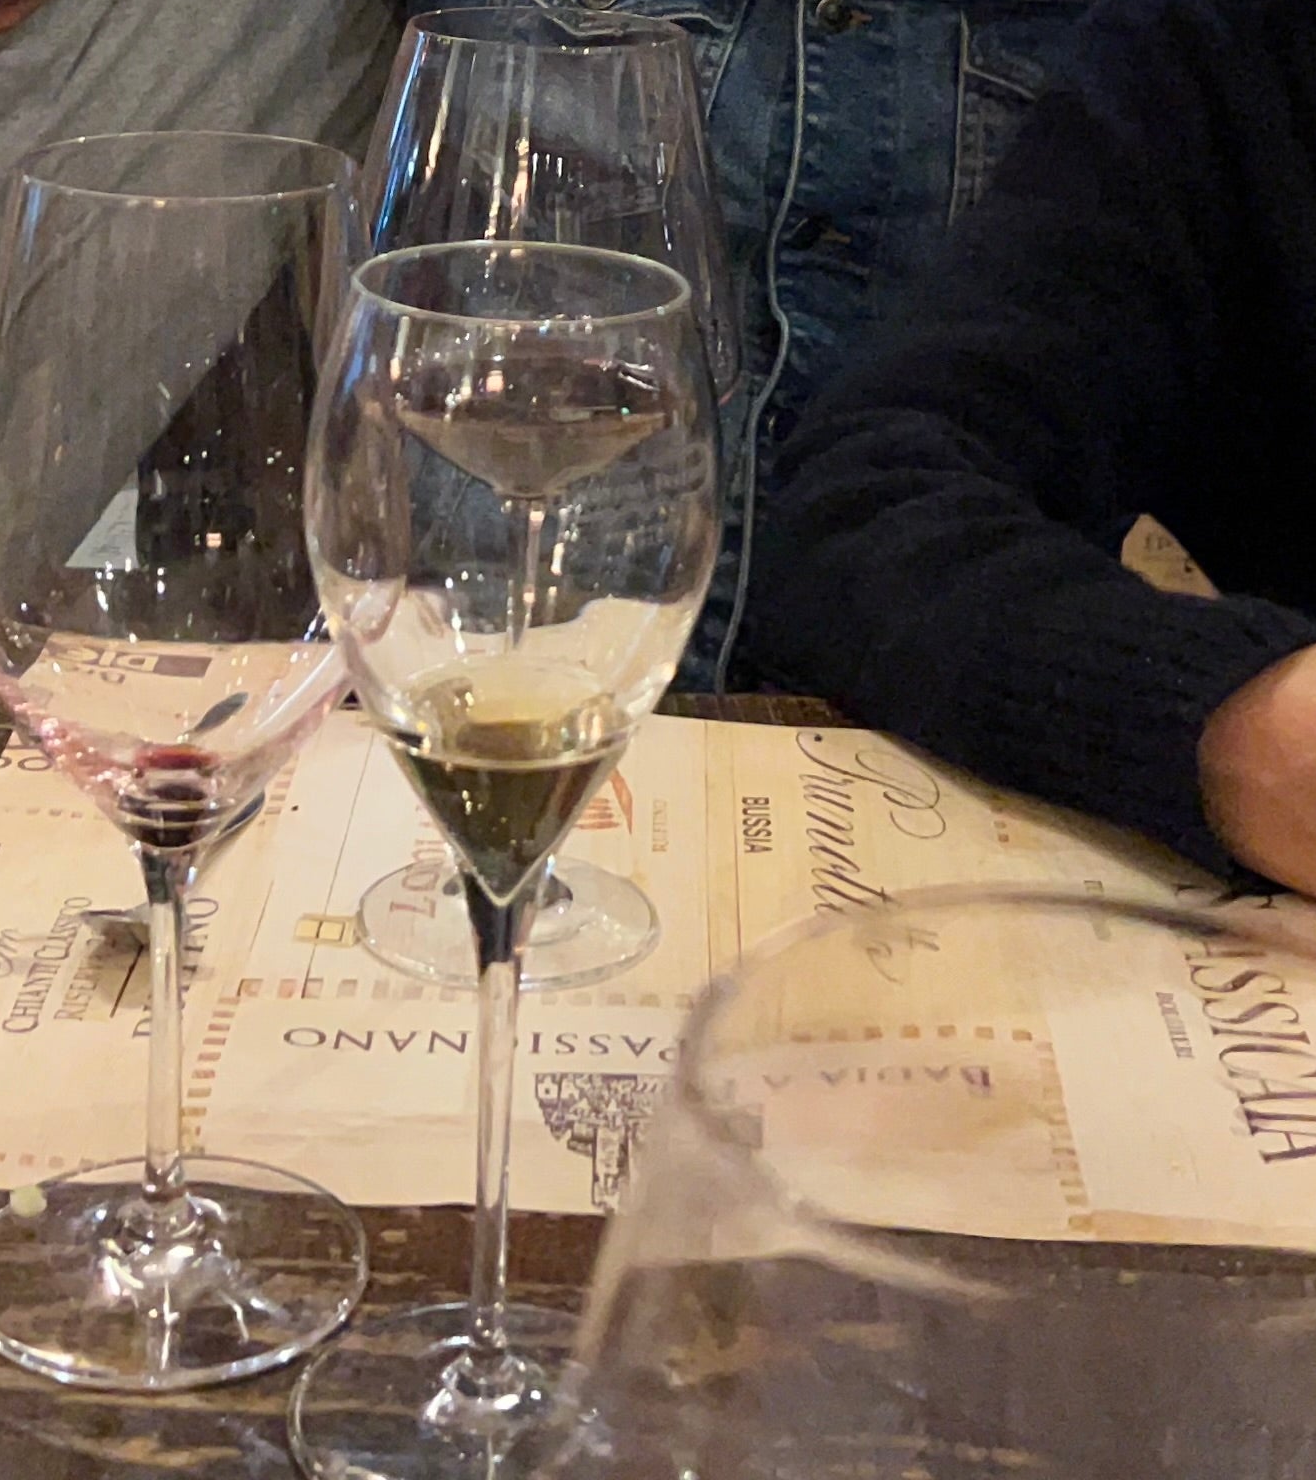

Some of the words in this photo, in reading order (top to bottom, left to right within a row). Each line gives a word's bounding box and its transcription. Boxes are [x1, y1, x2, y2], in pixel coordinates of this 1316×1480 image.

[741, 795, 773, 854] BUSSIA
[1, 957, 57, 1034] CHIANTI
[282, 1026, 684, 1065] PASSINANO
